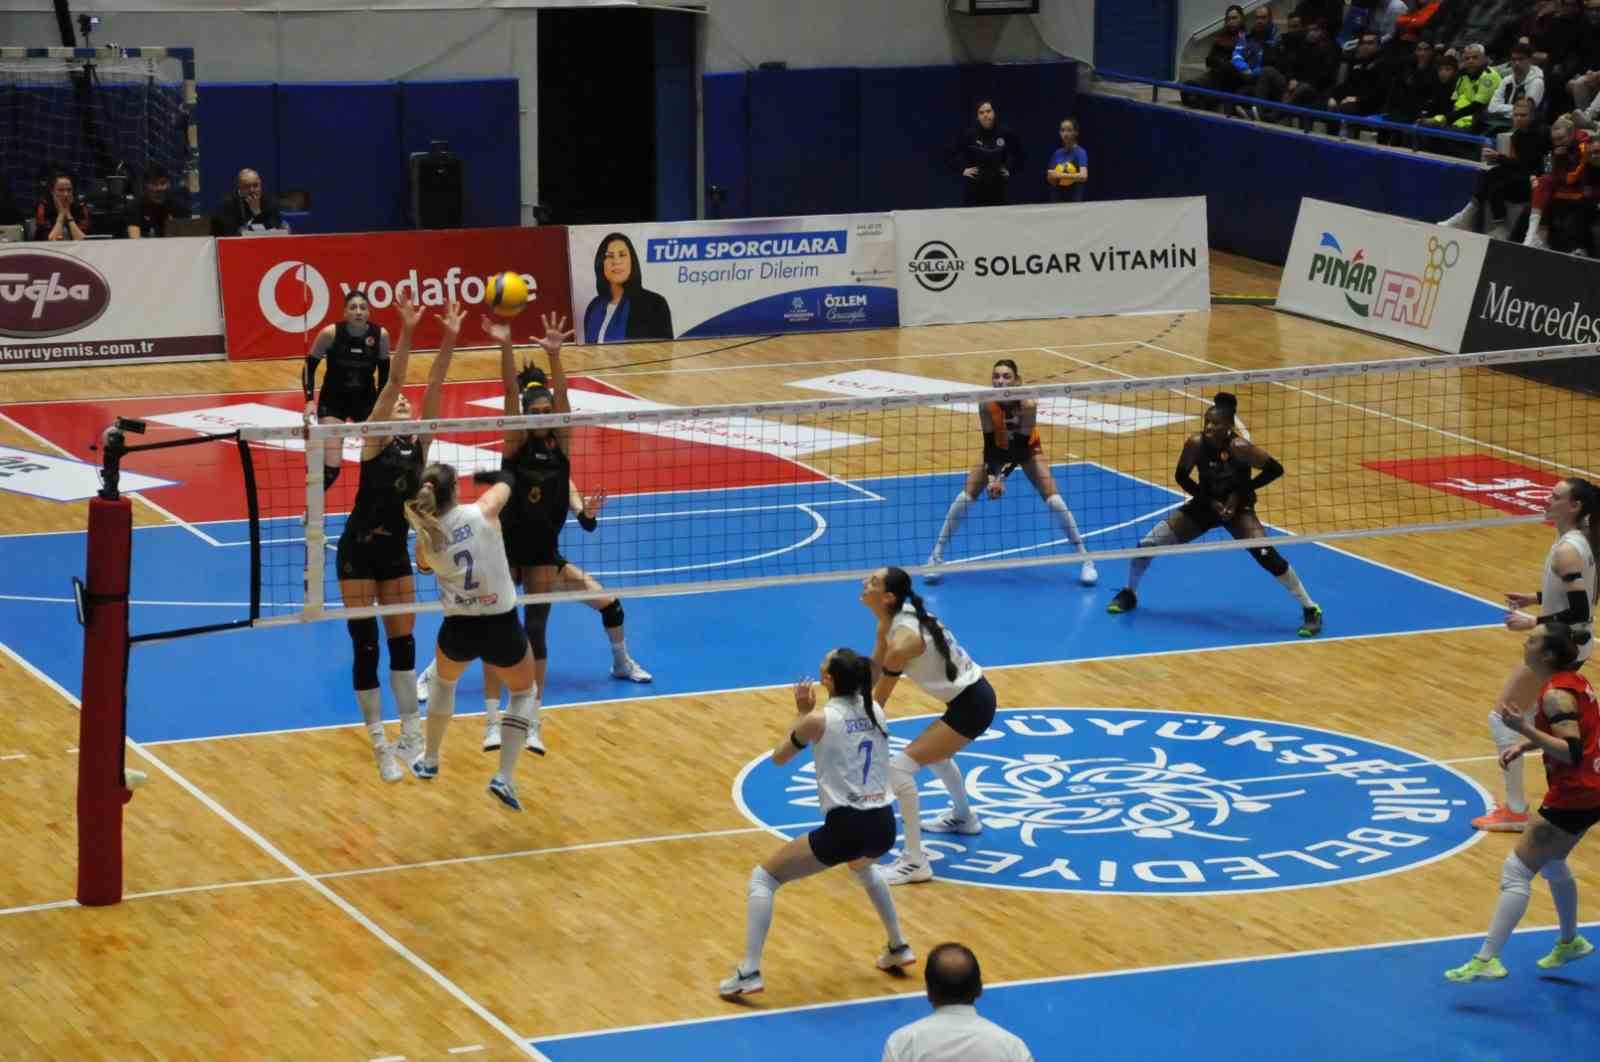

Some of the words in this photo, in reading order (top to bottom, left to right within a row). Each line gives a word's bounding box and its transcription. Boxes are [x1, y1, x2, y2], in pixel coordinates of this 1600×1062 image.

[654, 239, 698, 261] TÜM
[704, 237, 839, 259] SPORCULARA
[975, 253, 1081, 277] SOLGAR
[1090, 243, 1197, 272] VİTAMİN
[677, 263, 754, 285] Başarılar
[760, 259, 819, 280] Dilerim
[908, 258, 965, 274] SOLGAR
[340, 267, 538, 309] vodafoe
[824, 294, 867, 308] ÖZLEM
[453, 549, 480, 591] 2
[857, 740, 873, 785] 7
